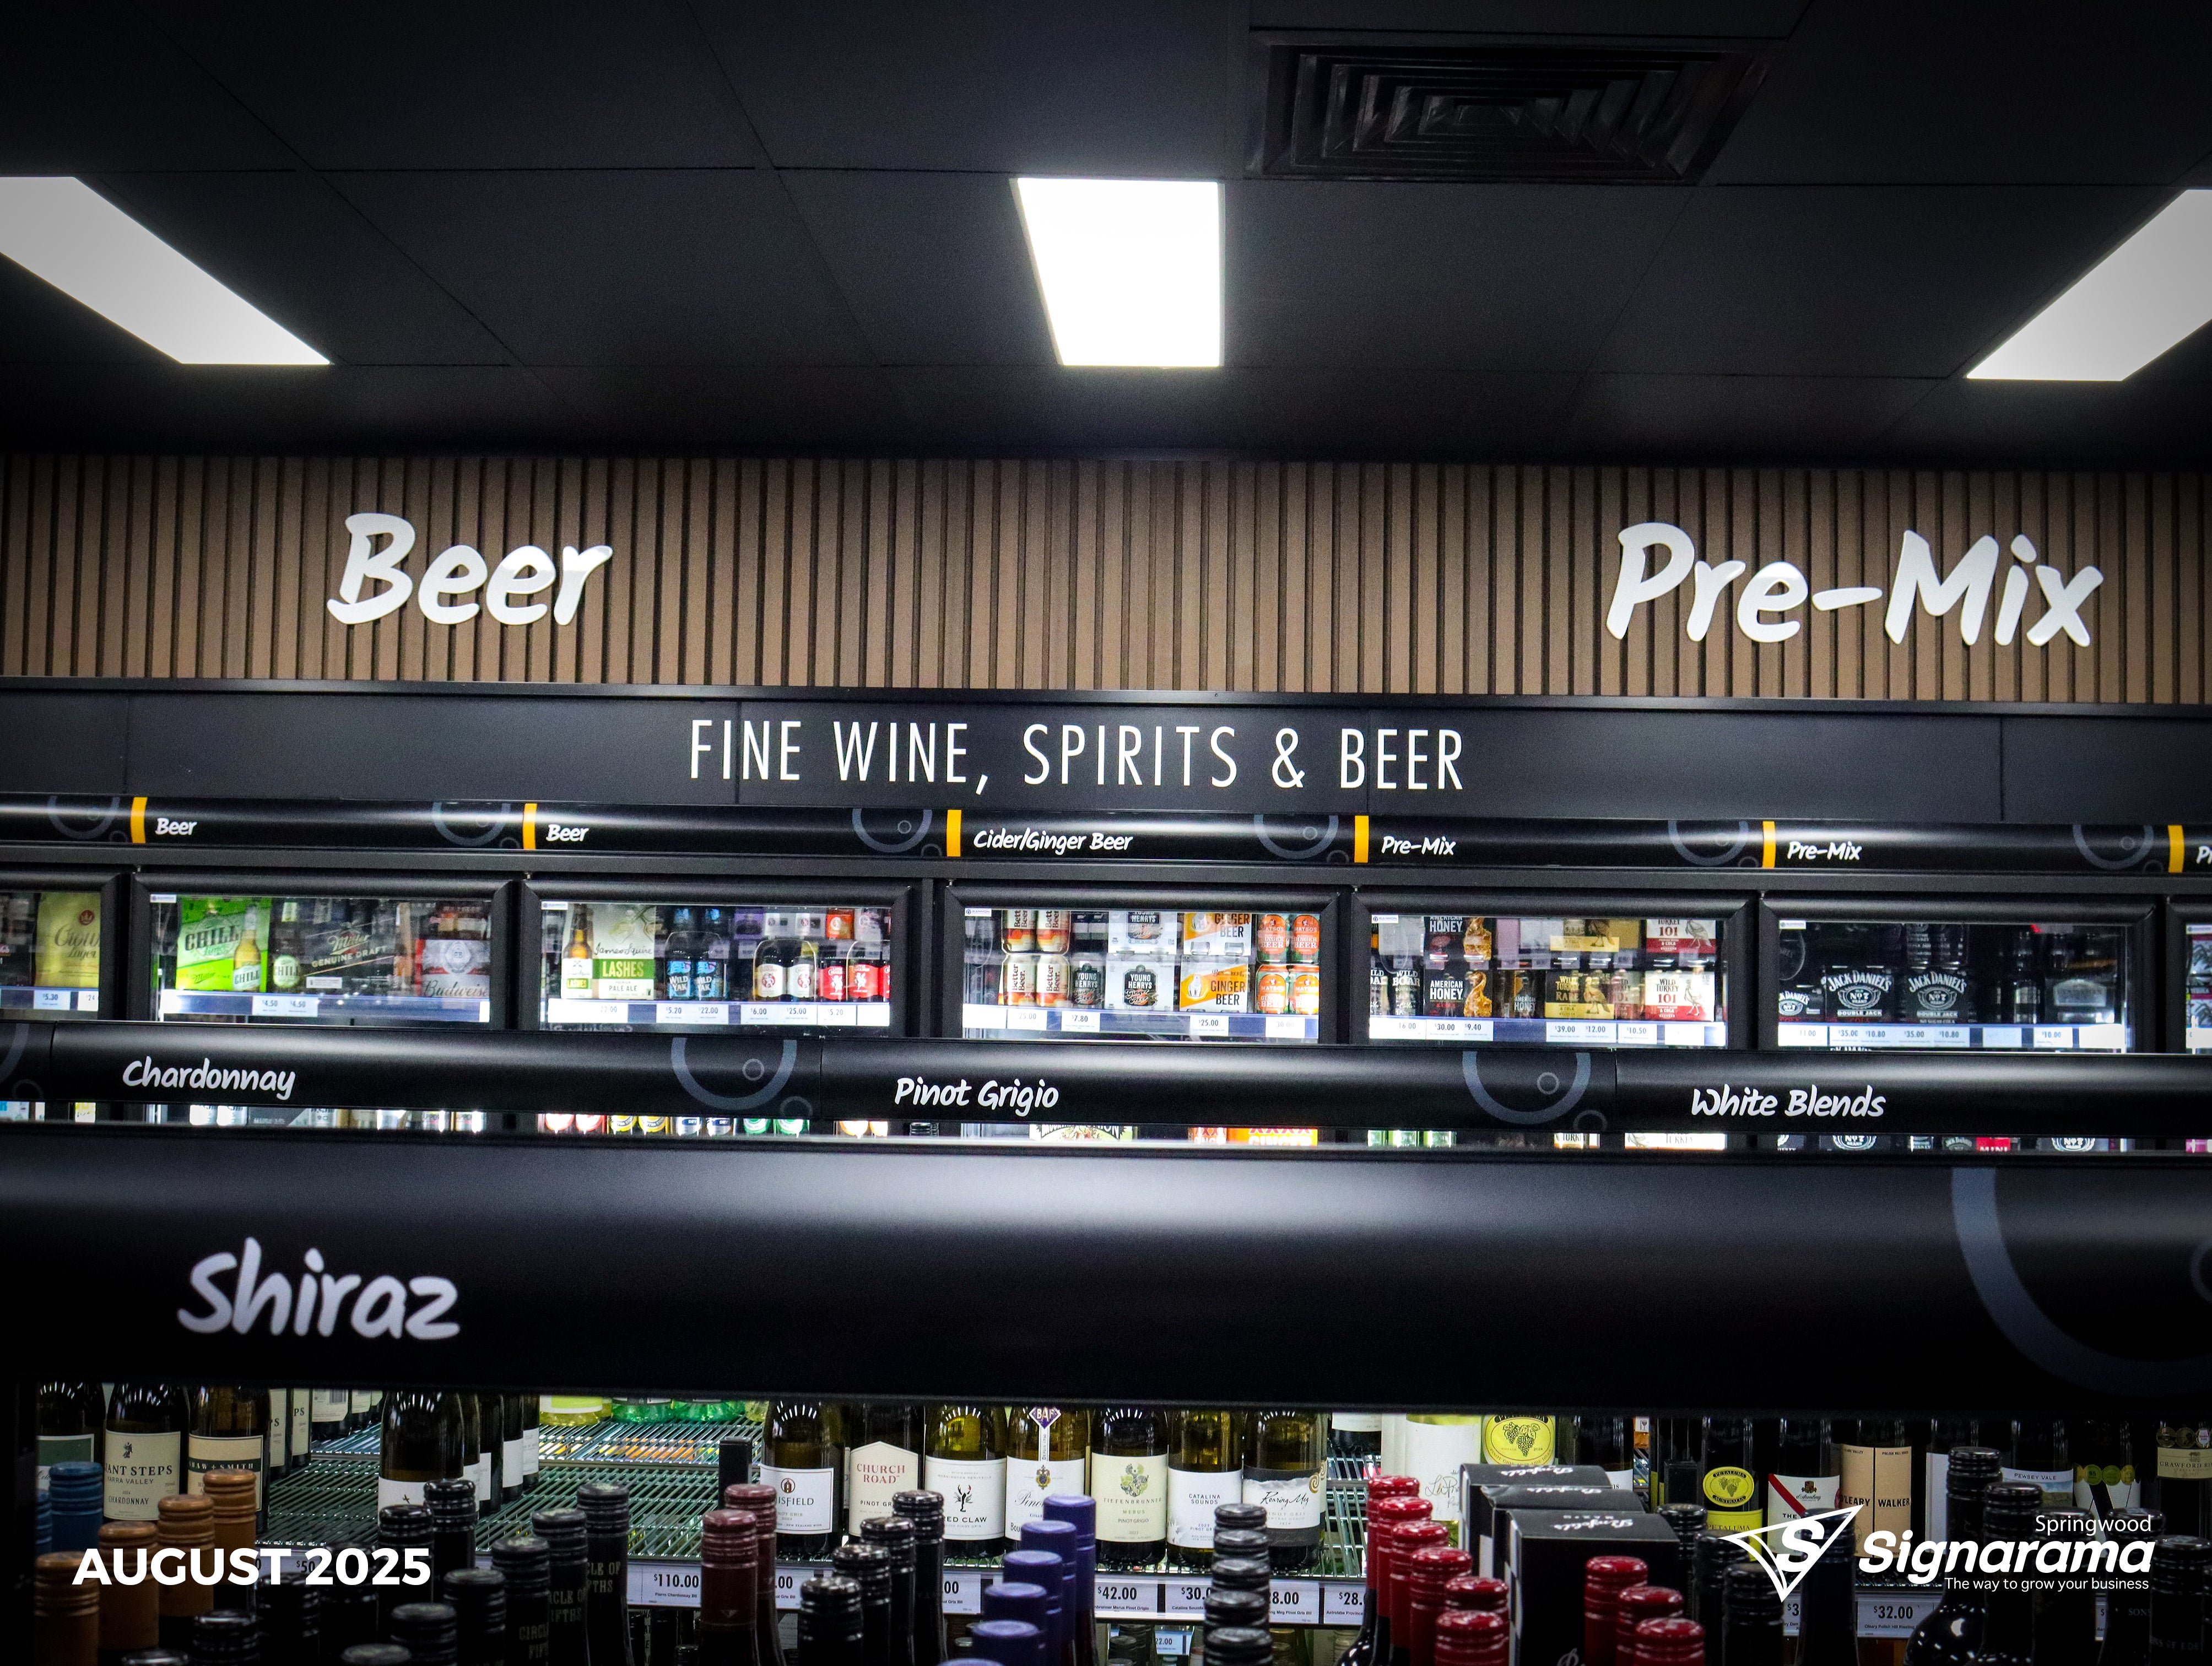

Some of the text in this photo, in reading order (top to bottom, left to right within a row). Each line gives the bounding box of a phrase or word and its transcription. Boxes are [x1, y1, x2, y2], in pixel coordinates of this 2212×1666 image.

[327, 512, 613, 625] Beer
[1607, 522, 2103, 647] Pre-Mix
[690, 720, 1463, 795] FINE WINE, SPIRITS & BEER
[155, 818, 197, 836] Beer
[545, 824, 589, 842] Beer
[973, 827, 1133, 856] Cider/Ginger Beer
[1381, 835, 1457, 855] Pre-Mix
[1787, 840, 1863, 861] Pre-Mix
[1220, 926, 1244, 938] BEER
[1430, 921, 1463, 932] HONEY
[1659, 927, 1679, 937] 101
[185, 926, 240, 951] CHILL
[328, 934, 370, 951] Miller
[311, 945, 387, 967] GENUINE DRAFT
[602, 960, 645, 978] LASHES
[234, 970, 260, 985] CHILL
[669, 975, 688, 985] WILD
[1077, 972, 1097, 981] YOUNG
[1130, 973, 1151, 982] YOUNG
[1392, 977, 1420, 987] BOAR
[1827, 970, 1892, 993] JACK DANIEL'S
[1908, 971, 1967, 994] JACK DANIEL'S
[423, 979, 489, 998] Budweise
[1075, 980, 1099, 988] HENRYS
[1128, 981, 1153, 989] HENRYS
[1210, 980, 1246, 993] GINGER
[1430, 980, 1463, 988] AMERICAN
[1656, 985, 1679, 993] TURKEY
[1215, 994, 1240, 1006] BEER
[1429, 988, 1463, 1000] HONEY
[1658, 993, 1676, 1004] 101
[1515, 1002, 1536, 1012] HONEY
[123, 1056, 296, 1100] Chardonnay
[895, 1076, 1059, 1117] Pinot Grigio
[1691, 1084, 1886, 1117] White Blends
[177, 1236, 461, 1340] Shiraz
[104, 1463, 172, 1476] IANT STEPS
[857, 1463, 905, 1474] CHURCH
[863, 1474, 897, 1484] ROAD
[108, 1495, 149, 1505] CHARDONNAY
[776, 1497, 815, 1507] ISFIELD
[1014, 1489, 1045, 1508] Pino
[1261, 1491, 1310, 1507] Roaring Meg
[1714, 1495, 1746, 1504] AUSTRALIA
[1878, 1497, 1911, 1508] WALKER
[653, 1573, 699, 1589] $110.00
[1097, 1586, 1137, 1600] $42.00
[1181, 1586, 1212, 1600] $30.0
[1873, 1606, 1913, 1620] $32.00
